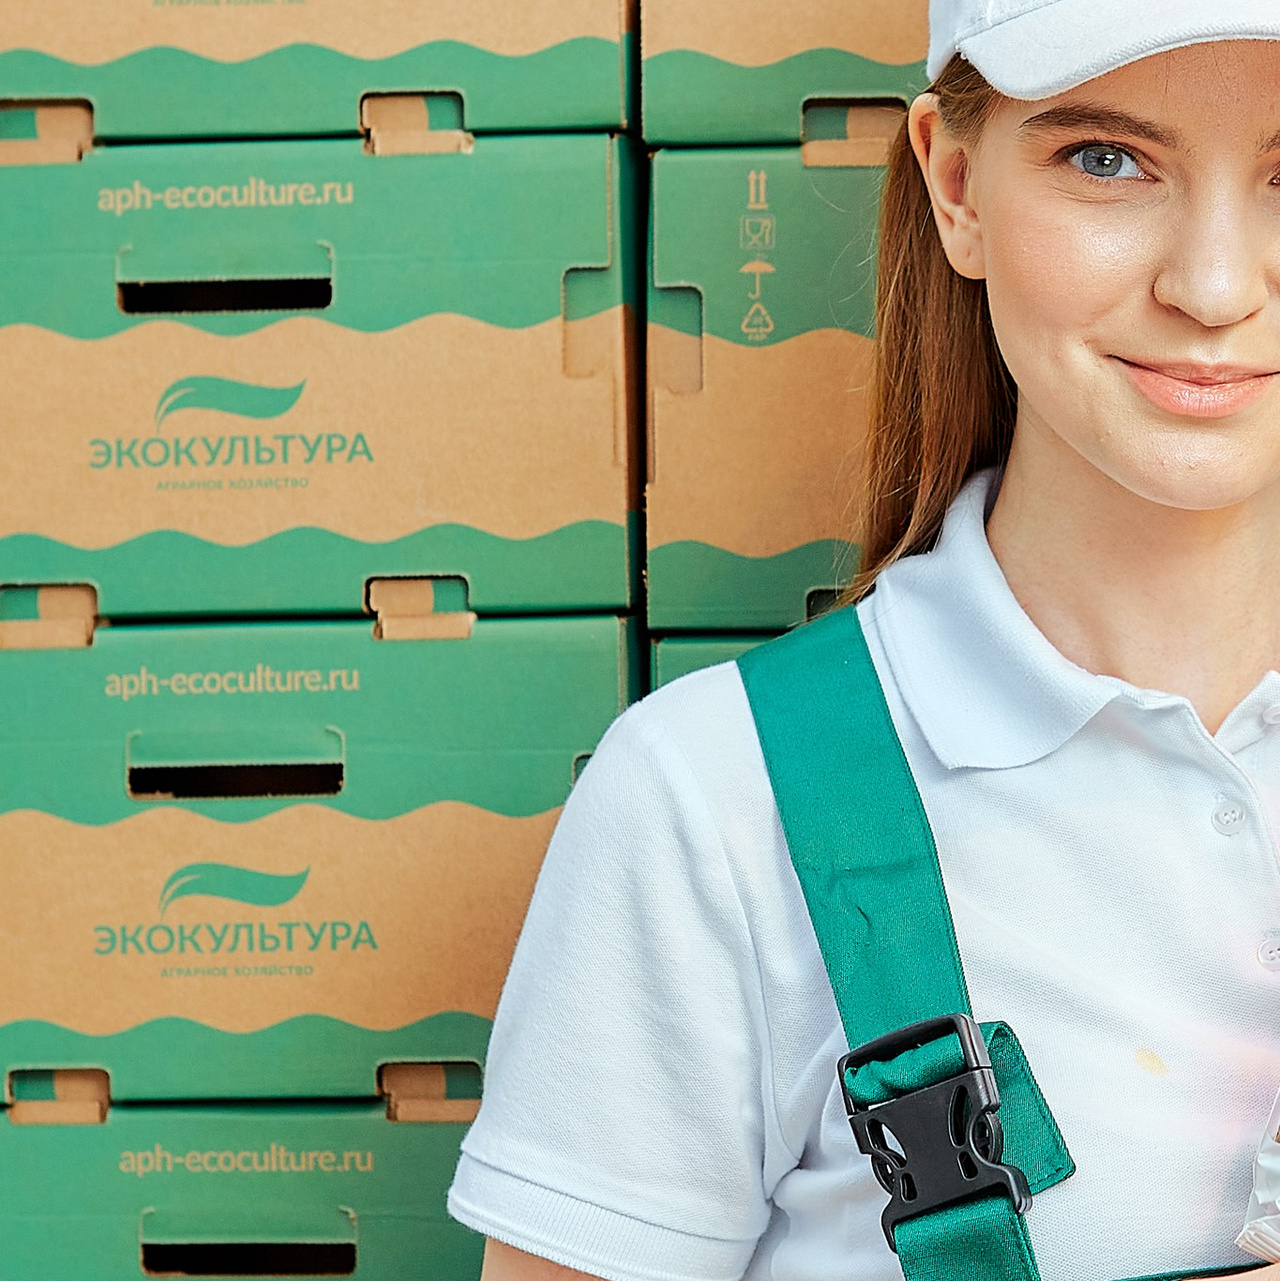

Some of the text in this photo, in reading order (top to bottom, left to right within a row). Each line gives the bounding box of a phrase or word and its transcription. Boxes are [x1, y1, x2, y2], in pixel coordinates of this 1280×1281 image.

[98, 177, 353, 215] aph-ecoculture.ru
[90, 433, 374, 469] ЭКОКУЛЬТУРА
[105, 664, 359, 700] aph-ecoculture.ru
[94, 921, 378, 956] ЭКОКУЛЬТУРА
[120, 1144, 374, 1176] aph-ecoculture.ru
